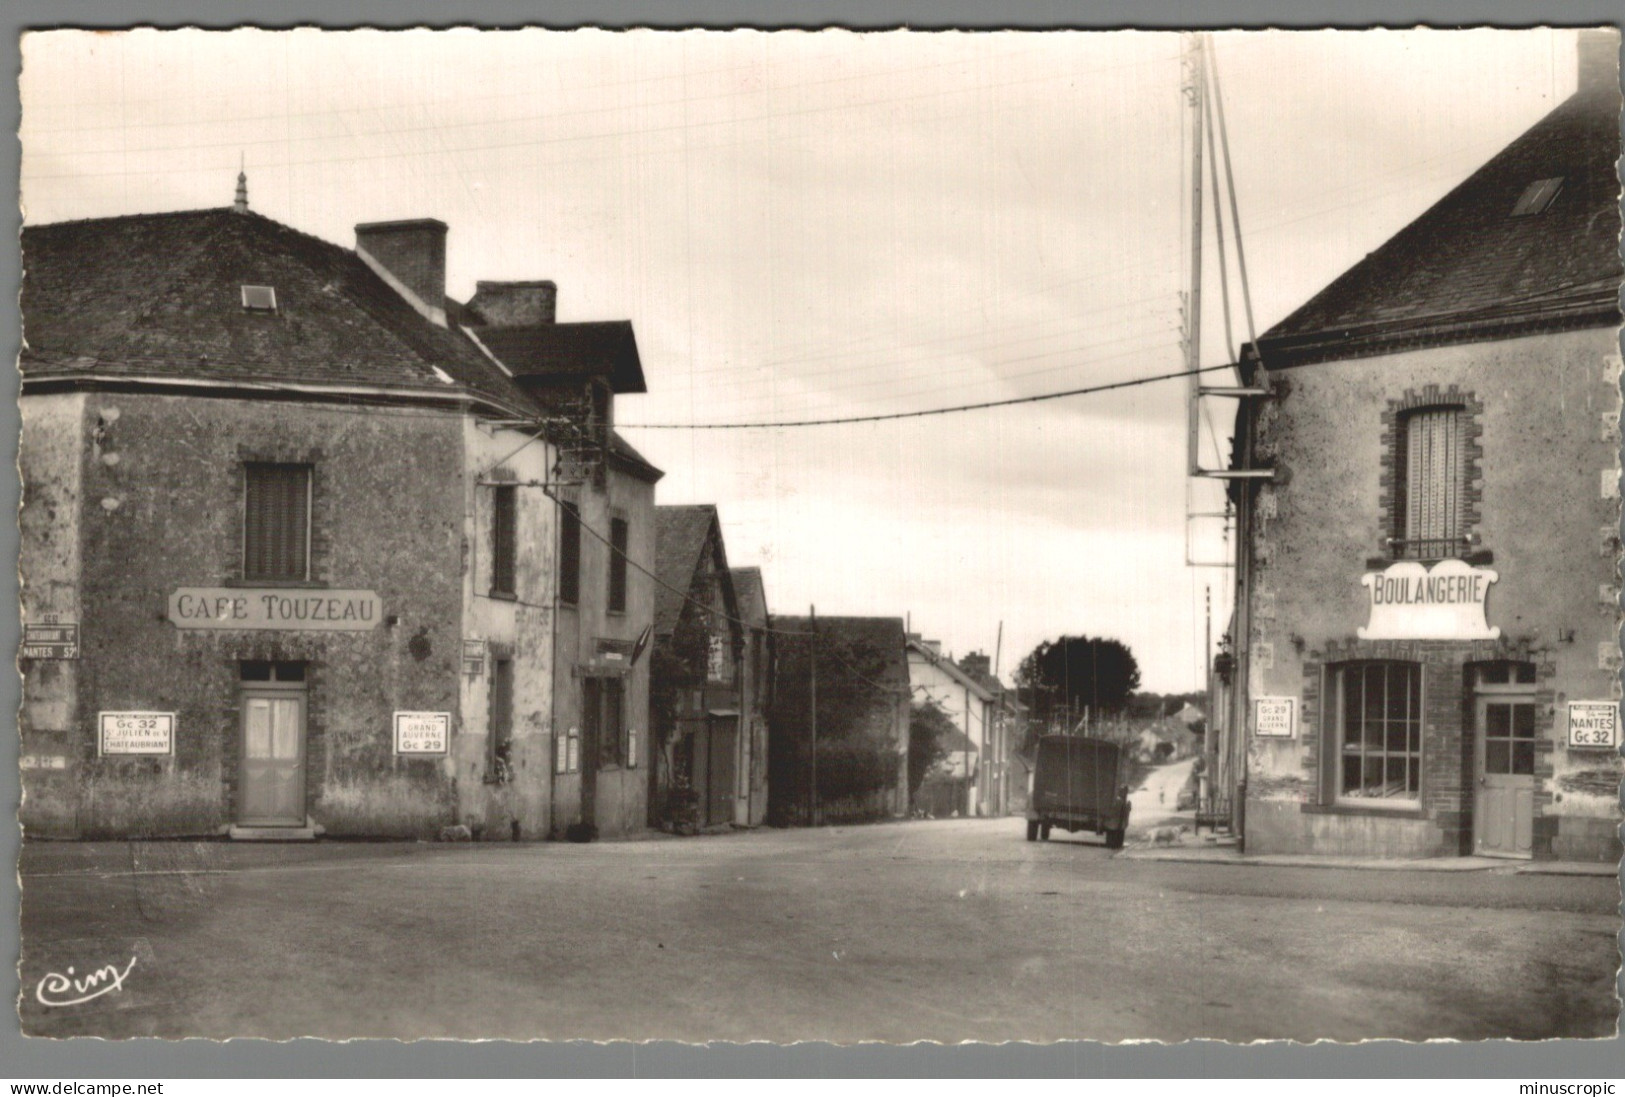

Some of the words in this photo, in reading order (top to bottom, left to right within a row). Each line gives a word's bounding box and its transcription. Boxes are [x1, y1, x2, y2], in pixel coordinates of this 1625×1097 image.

[1374, 574, 1483, 605] BOULANGERIE
[178, 594, 248, 619] CAFÉ
[262, 595, 374, 621] TOUZEAU
[23, 647, 53, 658] NANTES
[138, 720, 157, 729] 32
[1571, 718, 1613, 730] NANTES
[116, 729, 151, 737] JULIEN
[402, 731, 441, 739] AUVERNE
[1592, 730, 1609, 744] 32
[424, 740, 441, 750] 29
